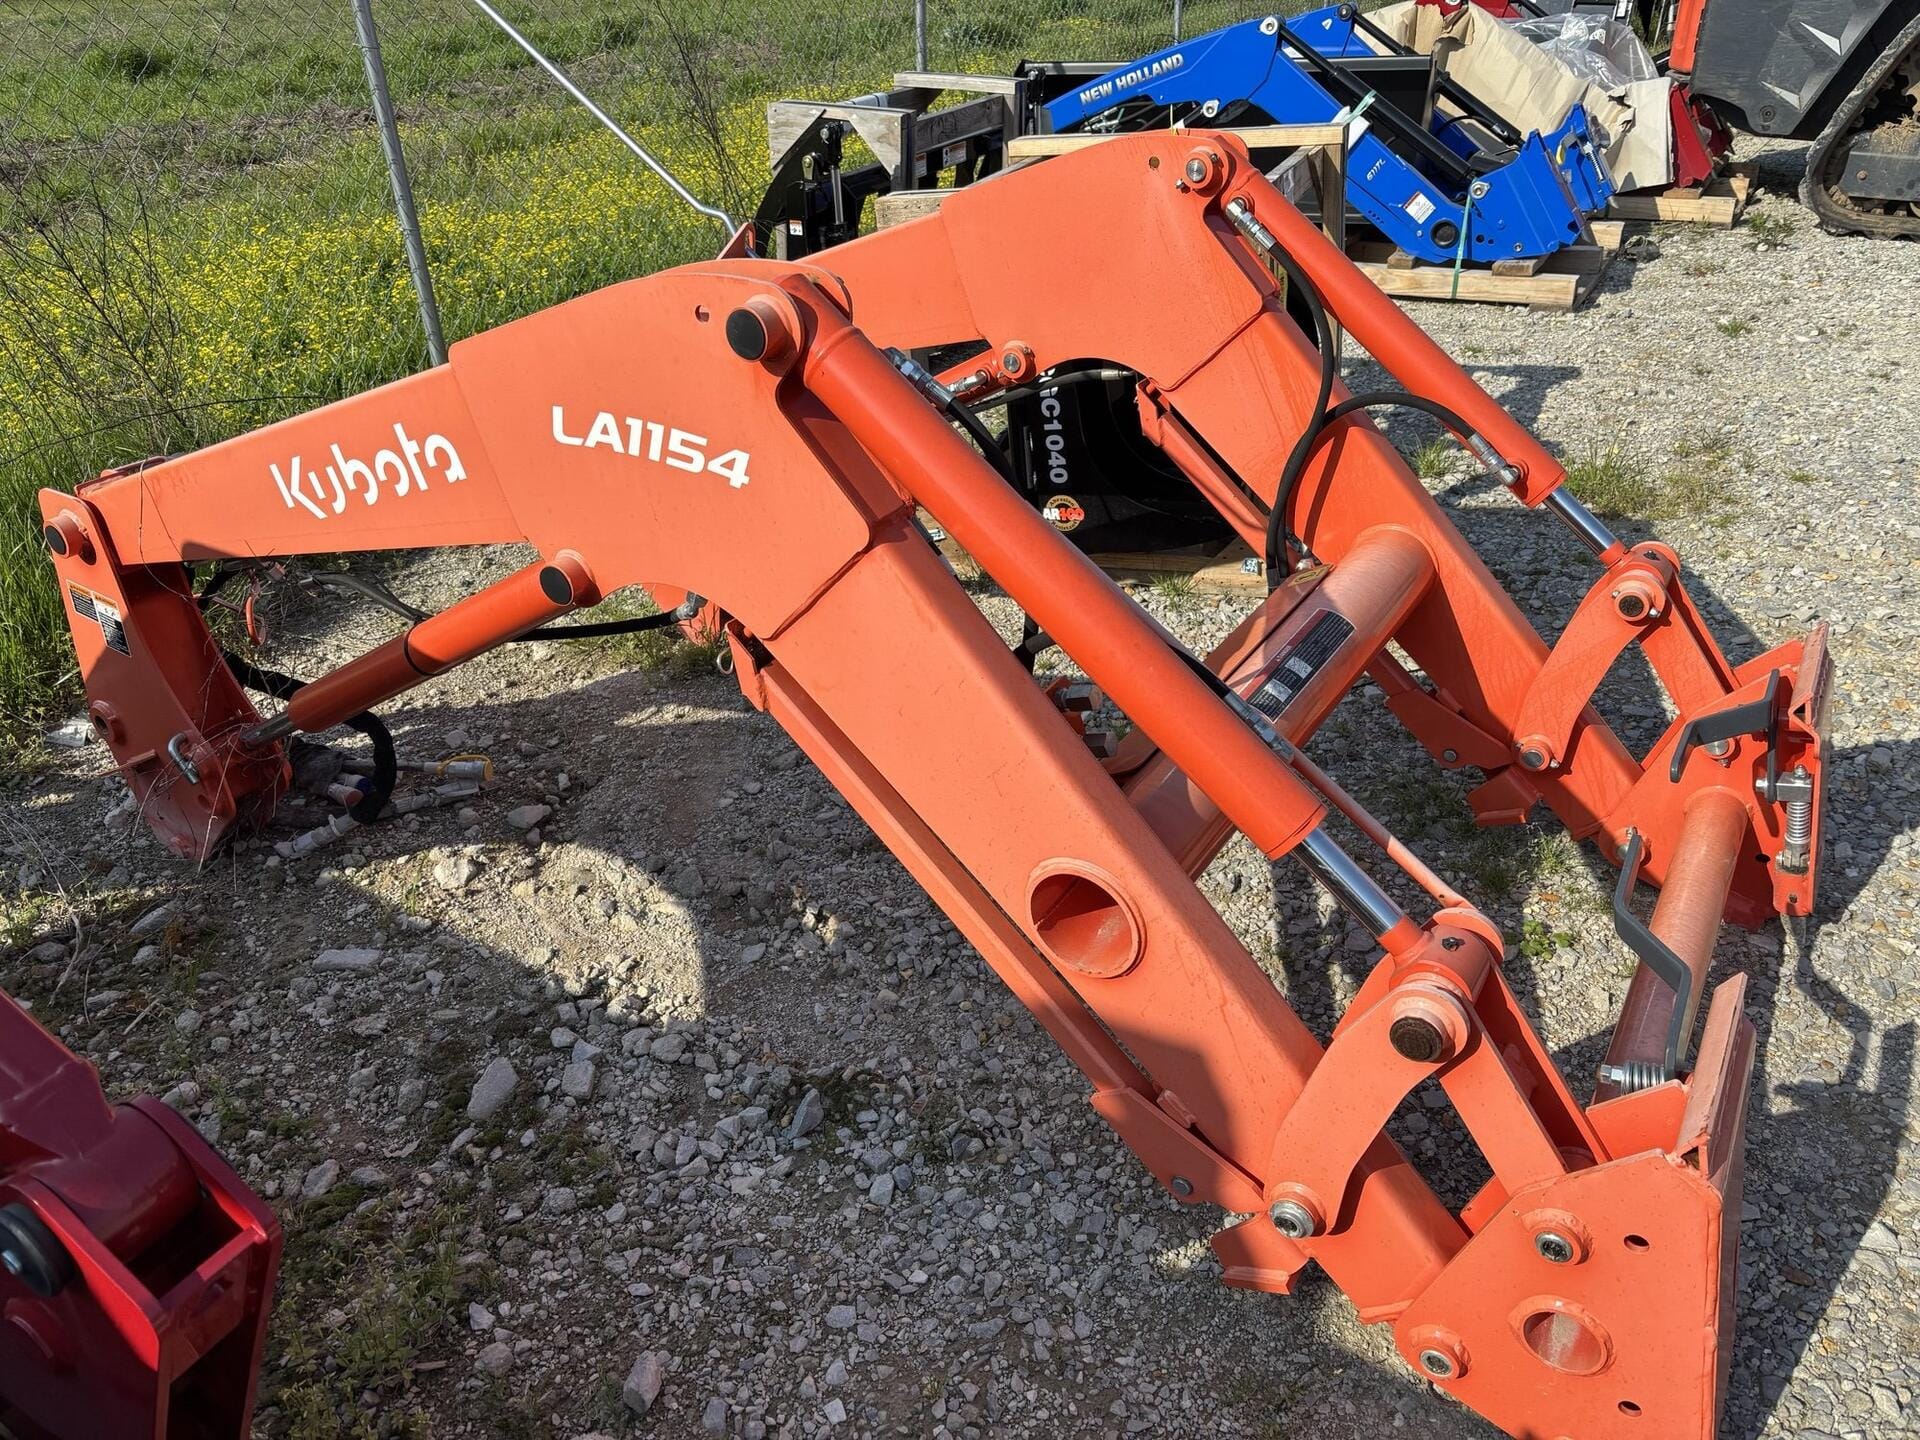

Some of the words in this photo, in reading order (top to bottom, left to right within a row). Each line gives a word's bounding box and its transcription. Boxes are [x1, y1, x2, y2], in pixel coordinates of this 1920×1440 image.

[1079, 81, 1112, 105] NEW
[1115, 53, 1184, 90] HOLLAND
[269, 422, 467, 519] Kubota
[552, 405, 751, 489] LA1154
[1043, 507, 1085, 521] AR400
